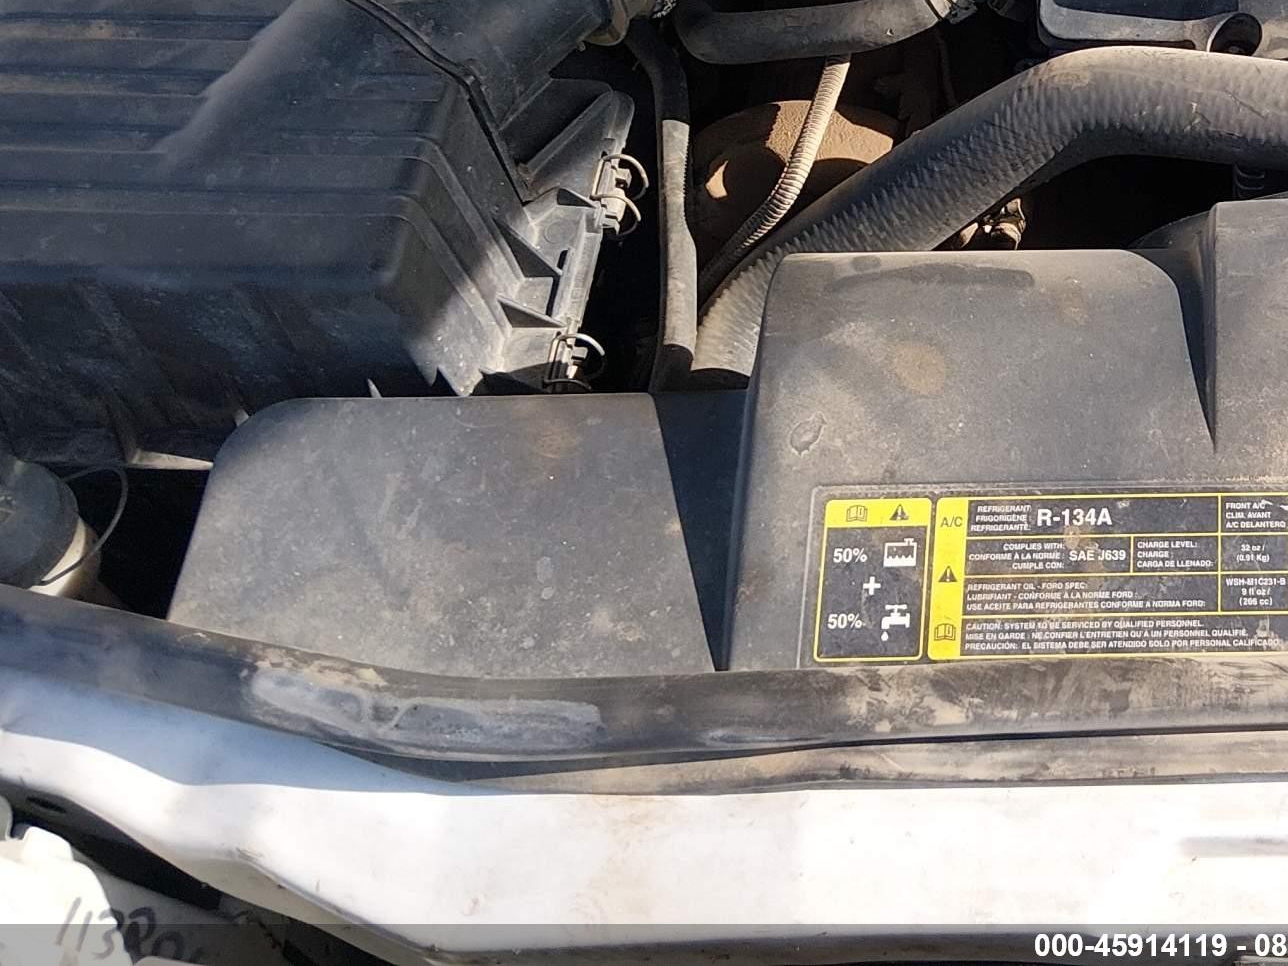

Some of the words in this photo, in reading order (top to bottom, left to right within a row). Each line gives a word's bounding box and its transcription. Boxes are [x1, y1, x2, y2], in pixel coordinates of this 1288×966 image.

[1226, 502, 1251, 510] FRONT
[1252, 502, 1265, 510] A/C
[1037, 508, 1112, 526] R-134A
[940, 516, 963, 529] A/C
[1226, 521, 1239, 529] A/C
[1240, 520, 1286, 529] DELANTERO
[833, 548, 868, 563] 50%
[969, 553, 1012, 561] CONFORME
[1021, 552, 1031, 560] LA
[1069, 550, 1095, 561] SAE
[1098, 550, 1127, 561] J639
[1012, 562, 1044, 570] CUMPLE
[1137, 560, 1163, 568] CARGA
[1165, 560, 1175, 568] DE
[1042, 582, 1063, 590] FORD
[1018, 592, 1060, 600] CONFORME
[1112, 591, 1133, 599] FORD
[984, 603, 1011, 611] ACEITE
[1012, 602, 1034, 610] PARA
[1035, 602, 1099, 610] REFRIGERANTES
[1101, 601, 1144, 609] CONFORME
[1152, 600, 1180, 608] NORMA
[828, 614, 862, 630] 50%
[1004, 622, 1036, 630] SYSTEM
[1062, 621, 1100, 629] SERVICED
[1102, 620, 1113, 628] BY
[1114, 620, 1155, 628] QUALIFIED
[986, 632, 997, 640] EN
[998, 632, 1026, 640] GARDE
[1164, 630, 1210, 638] PERSONNEL
[1022, 642, 1031, 650] EL
[1068, 641, 1090, 649] DEBE
[1108, 640, 1146, 648] ATENDIDO
